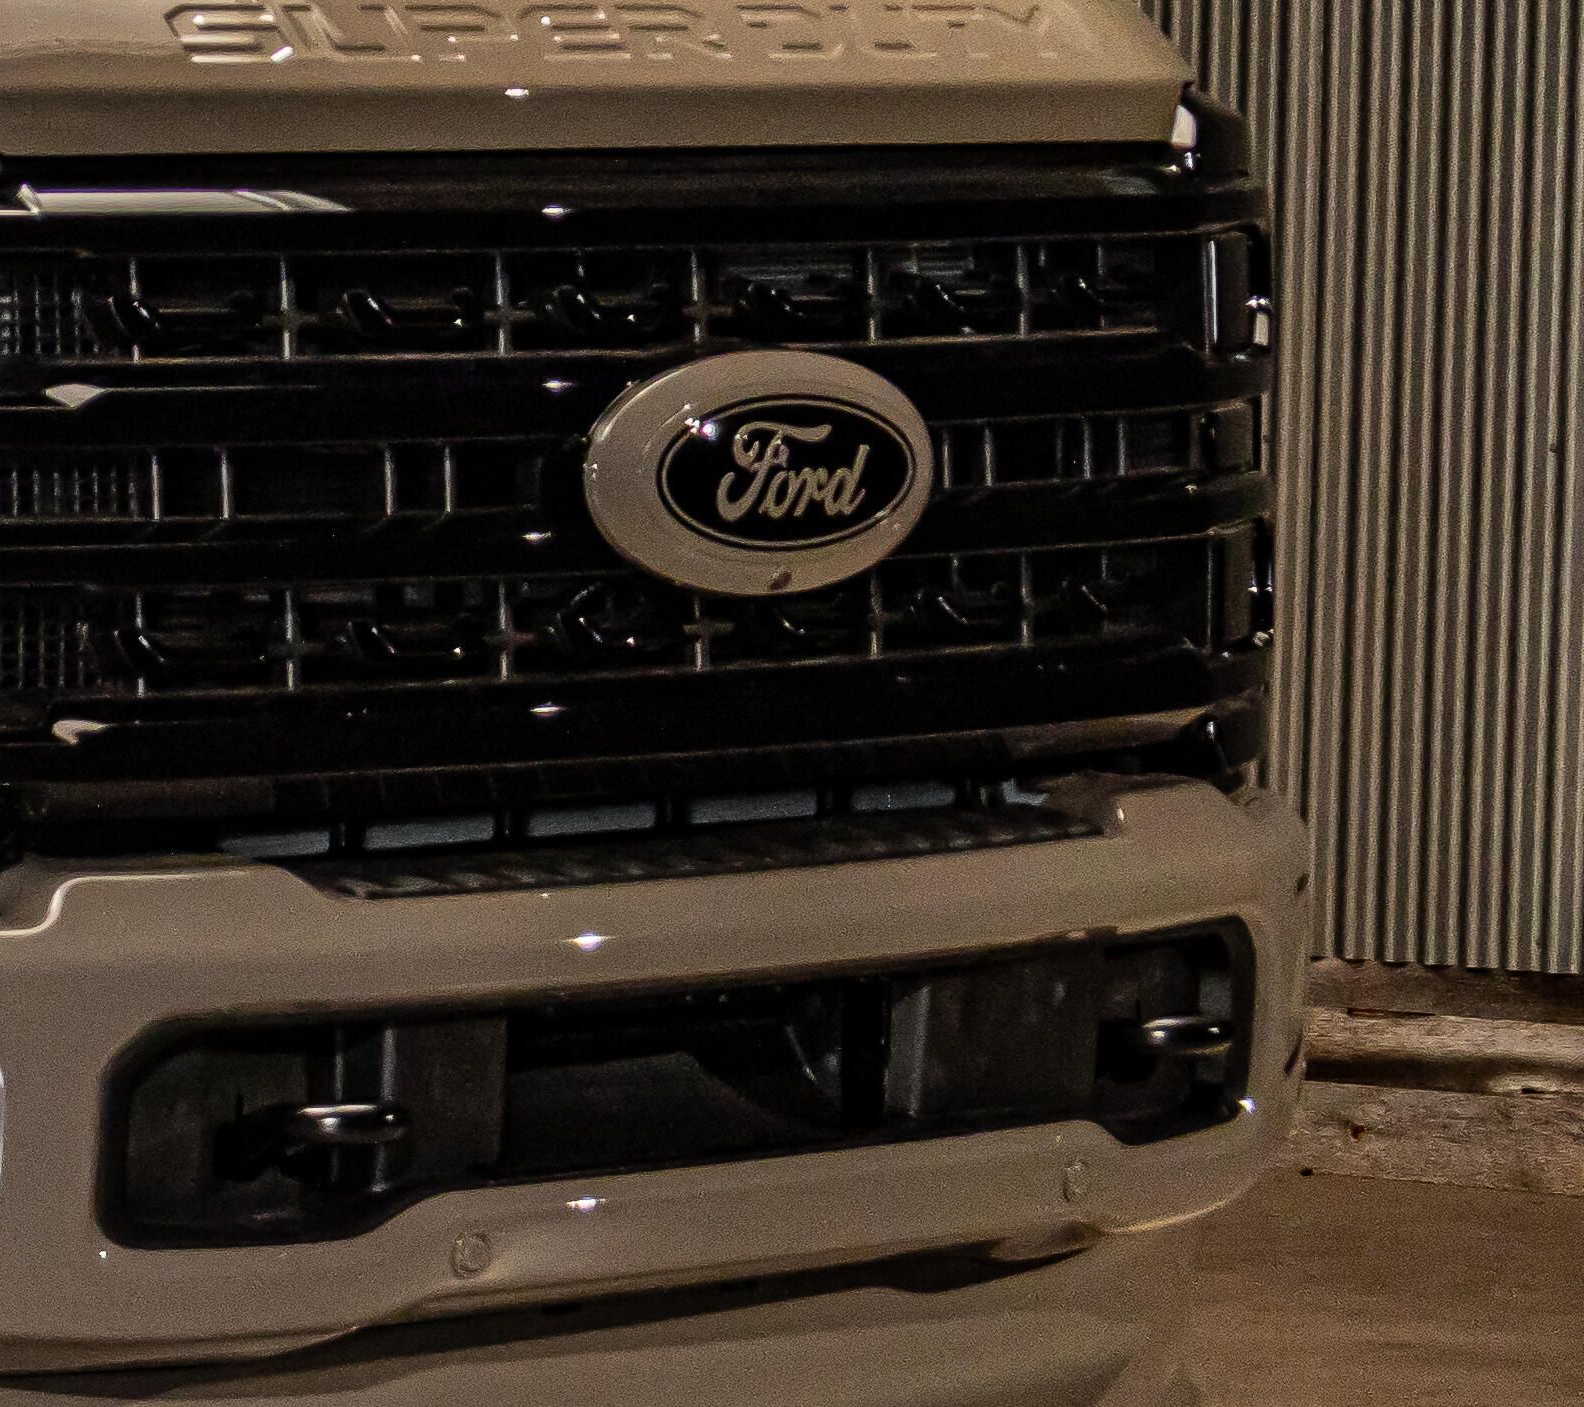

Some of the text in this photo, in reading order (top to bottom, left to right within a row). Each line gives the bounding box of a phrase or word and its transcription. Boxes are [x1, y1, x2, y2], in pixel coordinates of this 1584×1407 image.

[163, 2, 1056, 63] SUPER DUTY
[716, 420, 870, 523] Ford
